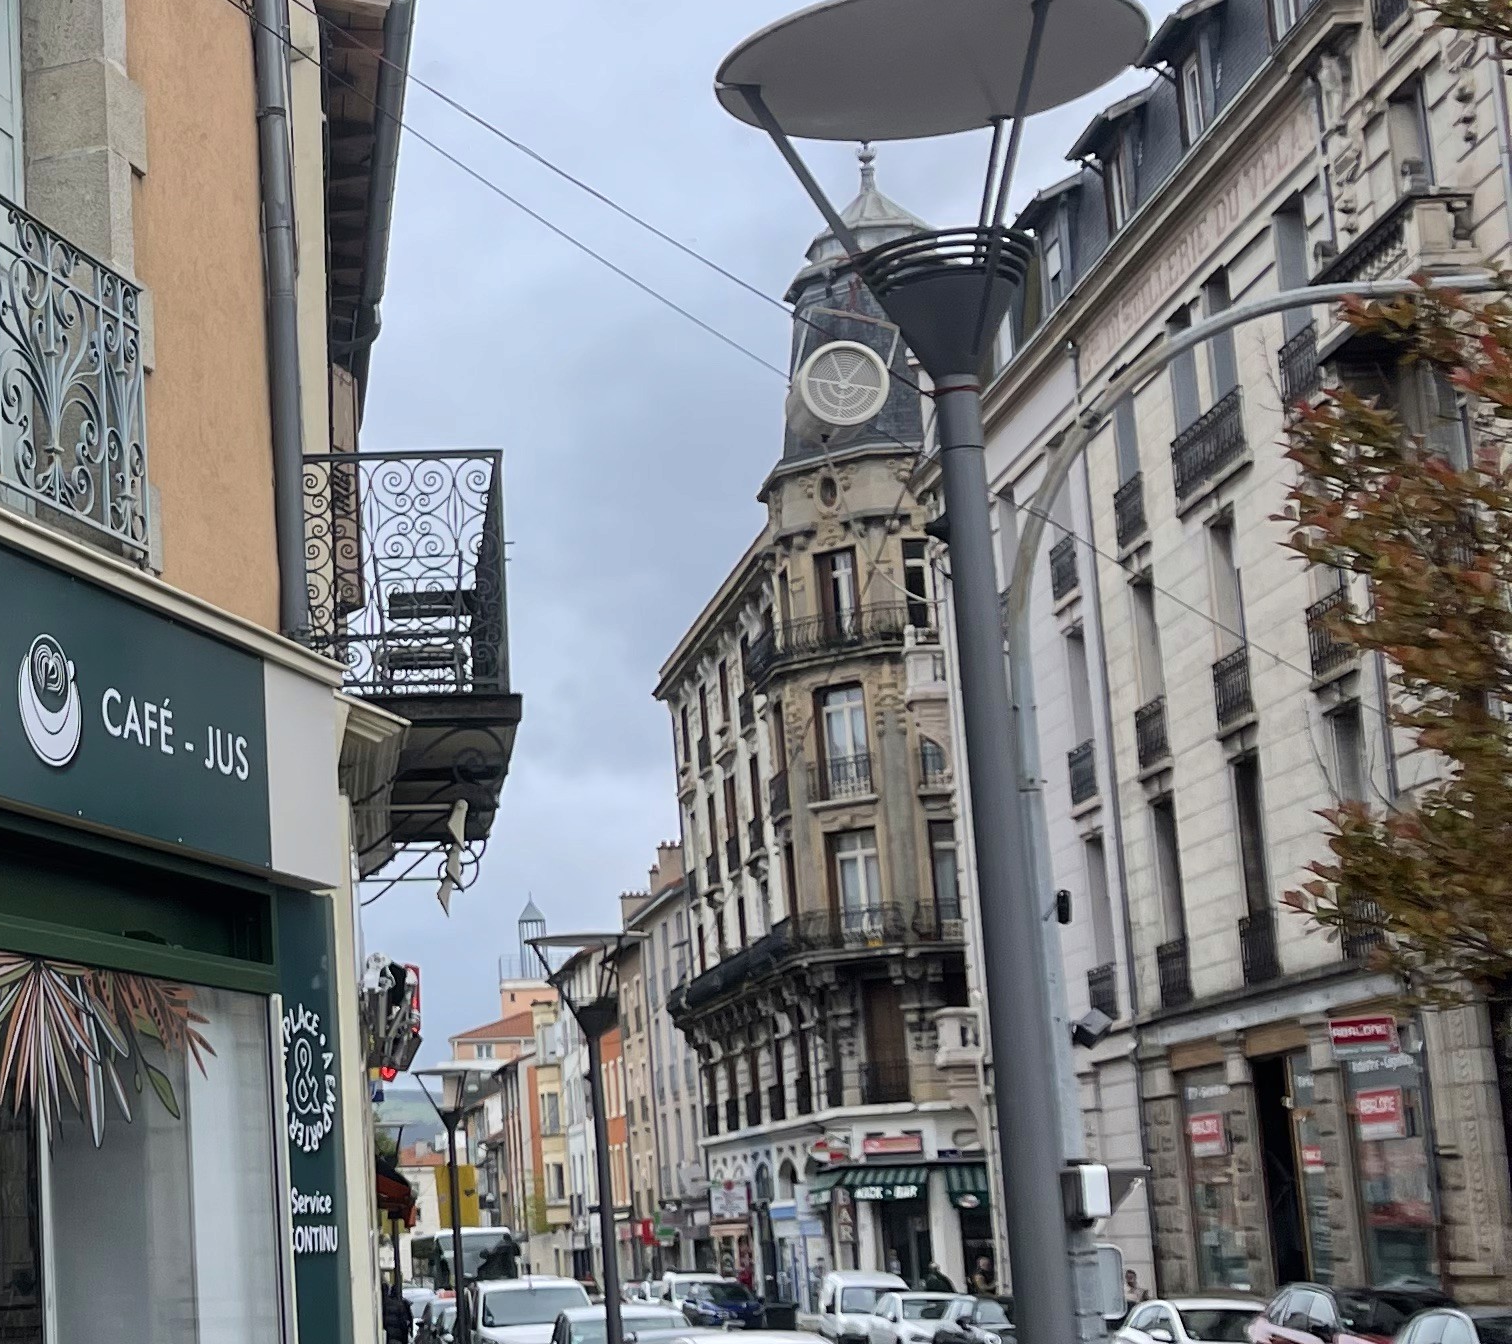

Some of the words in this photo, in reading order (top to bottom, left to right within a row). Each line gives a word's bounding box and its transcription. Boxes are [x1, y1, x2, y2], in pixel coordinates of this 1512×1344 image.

[1212, 181, 1241, 237] DU
[103, 688, 173, 754] CAFÉ
[205, 726, 248, 780] JUS
[283, 1002, 320, 1043] PLACE
[291, 1186, 332, 1215] Service
